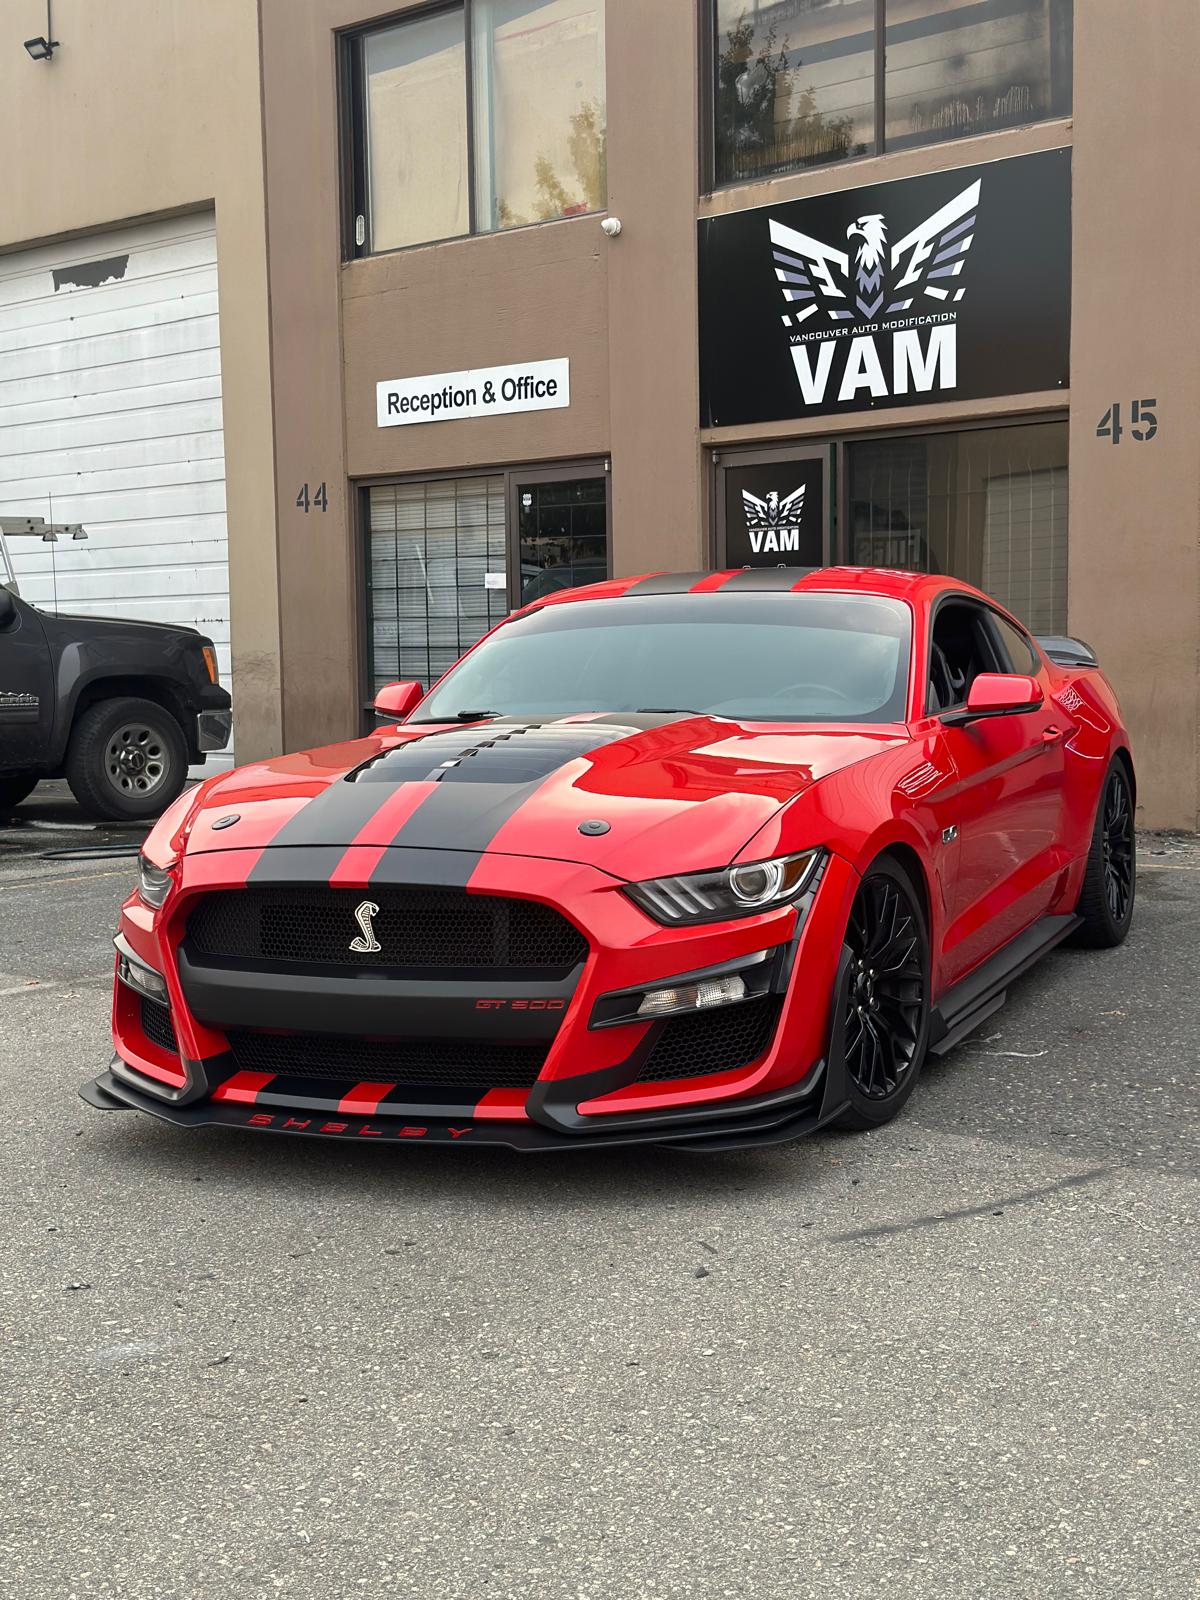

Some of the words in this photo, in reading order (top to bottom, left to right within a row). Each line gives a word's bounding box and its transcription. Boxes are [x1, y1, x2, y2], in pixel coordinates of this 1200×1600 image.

[789, 328, 848, 343] VANCOUVER
[851, 323, 878, 334] AUTO
[882, 312, 957, 330] MODIFICATION
[789, 323, 957, 405] VAM
[387, 386, 477, 415] Reception
[482, 380, 497, 404] &
[501, 376, 558, 401] Office
[1096, 398, 1158, 445] 45
[296, 482, 328, 513] 44
[748, 529, 800, 553] VAM
[475, 1000, 507, 1009] GT
[511, 1000, 564, 1009] 500
[247, 1113, 473, 1139] SHELBY
